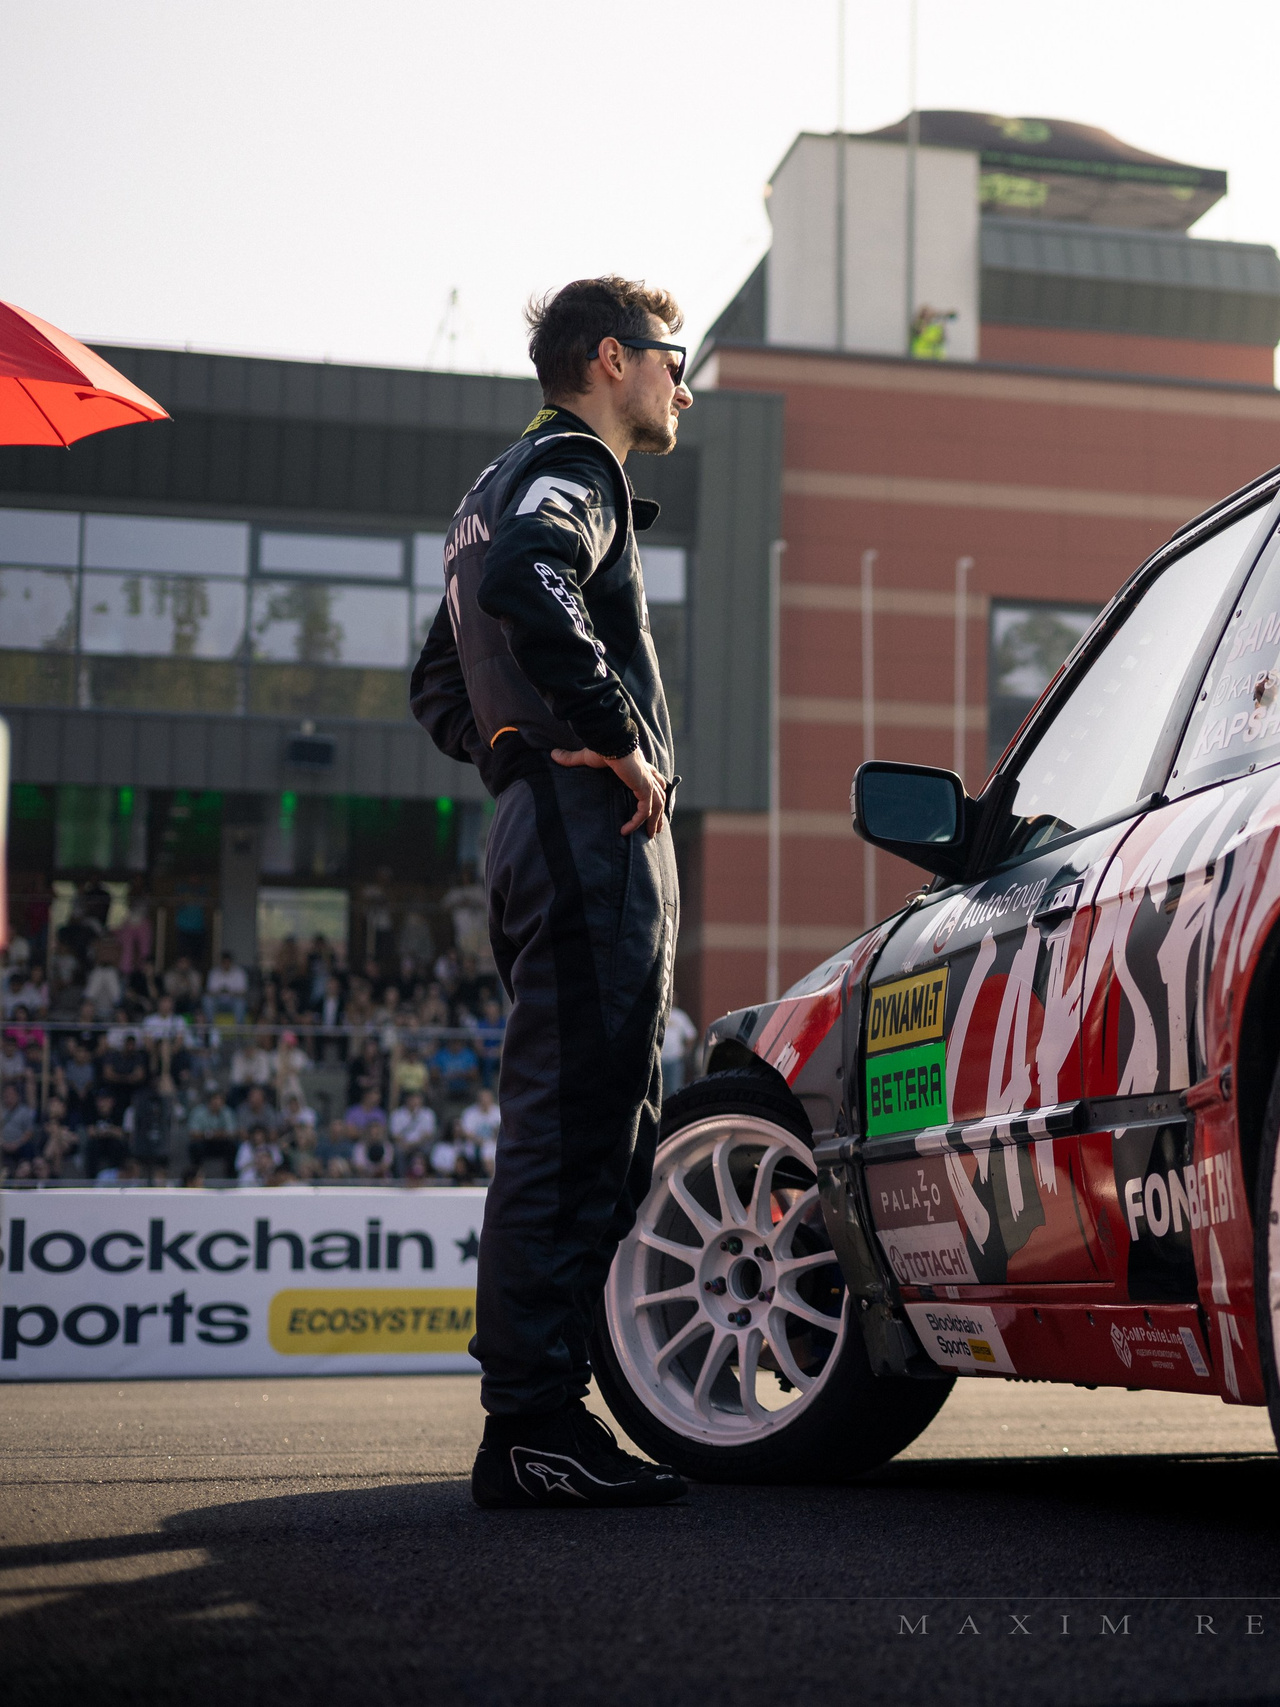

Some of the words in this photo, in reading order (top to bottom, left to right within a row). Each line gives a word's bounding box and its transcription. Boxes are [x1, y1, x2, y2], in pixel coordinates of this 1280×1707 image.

[957, 876, 1048, 932] AutoGroup
[0, 1217, 434, 1274] lockchain
[902, 1247, 969, 1279] TOTACHI
[287, 1306, 474, 1335] ECOSYSTEM
[925, 1313, 980, 1335] Blockchain
[936, 1335, 972, 1358] Sports
